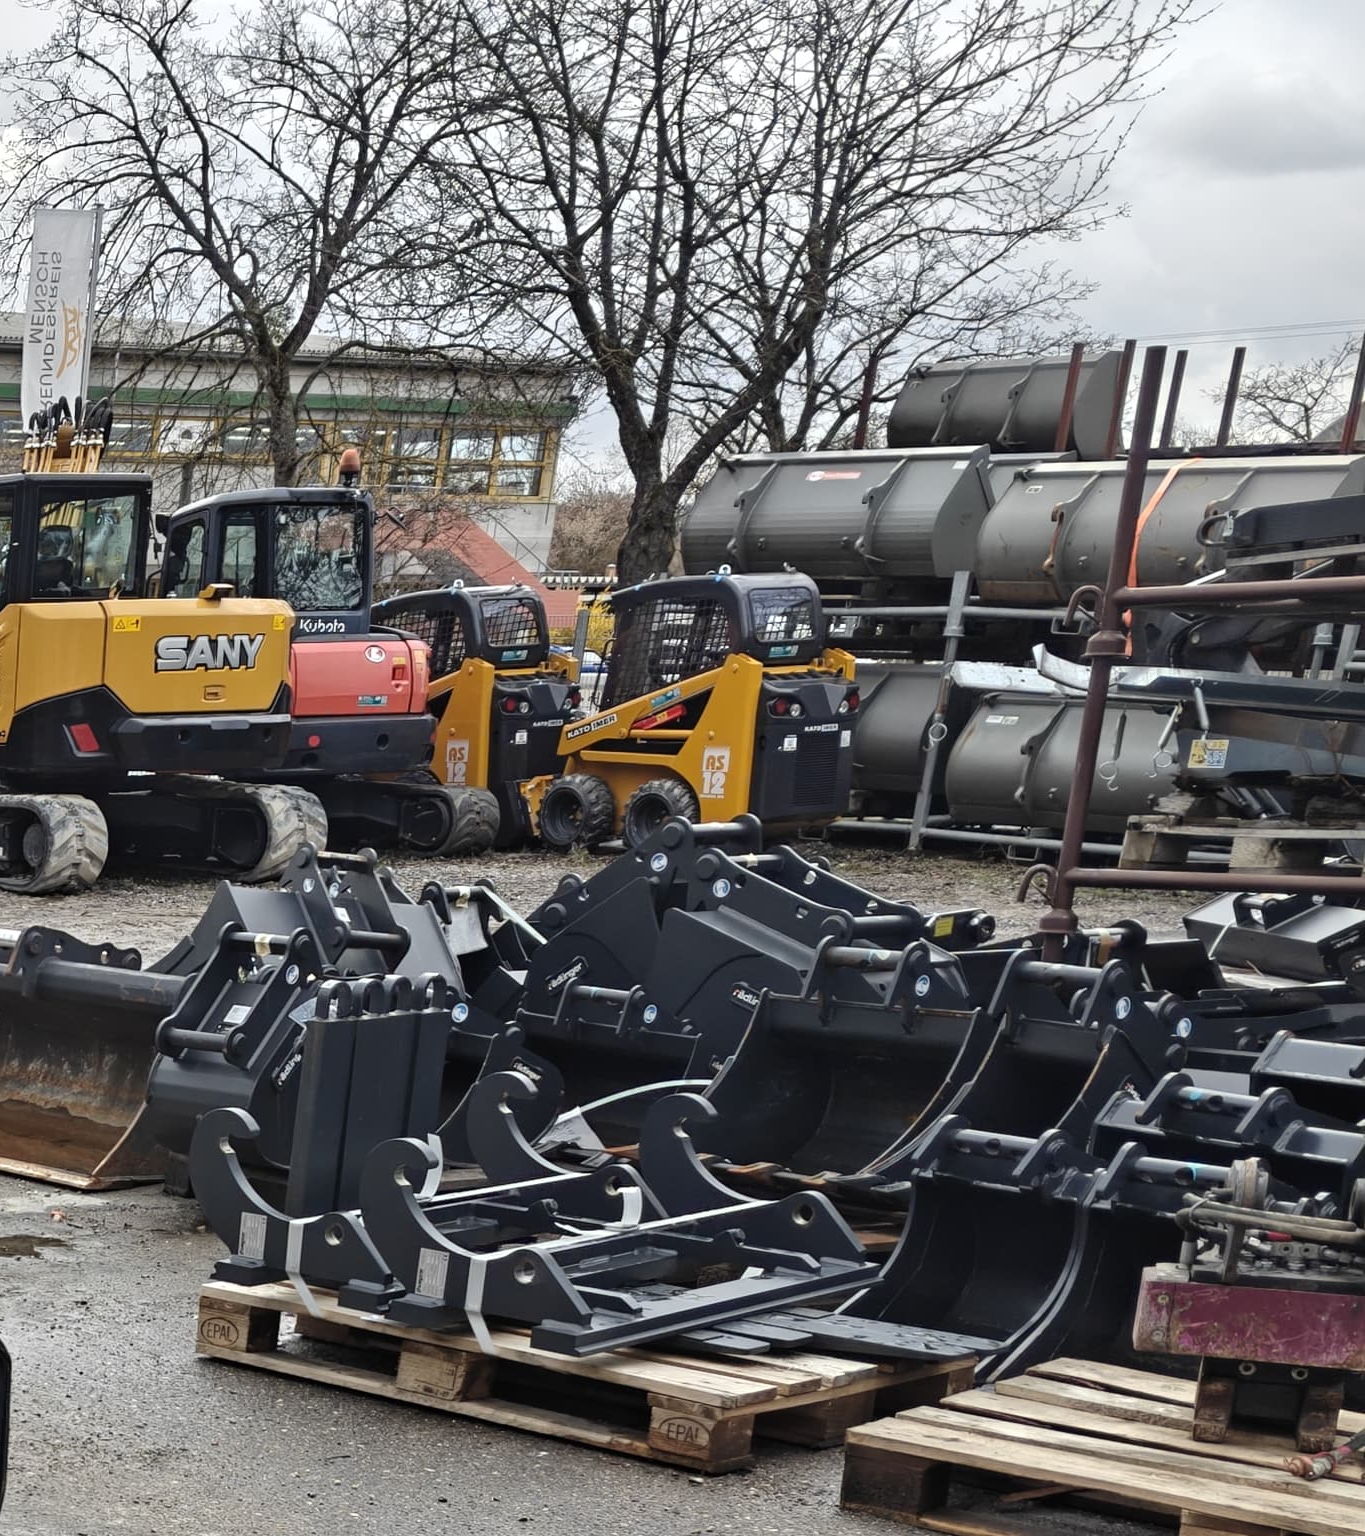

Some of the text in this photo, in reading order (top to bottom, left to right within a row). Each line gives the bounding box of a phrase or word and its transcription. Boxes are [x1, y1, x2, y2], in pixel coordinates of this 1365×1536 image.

[299, 618, 346, 633] Kubota
[154, 633, 266, 673] SANY
[567, 715, 617, 739] KATO IMER
[448, 747, 465, 761] AS
[705, 754, 725, 770] AS
[446, 762, 467, 783] 12
[702, 771, 726, 794] 12
[206, 1321, 233, 1343] EPAL
